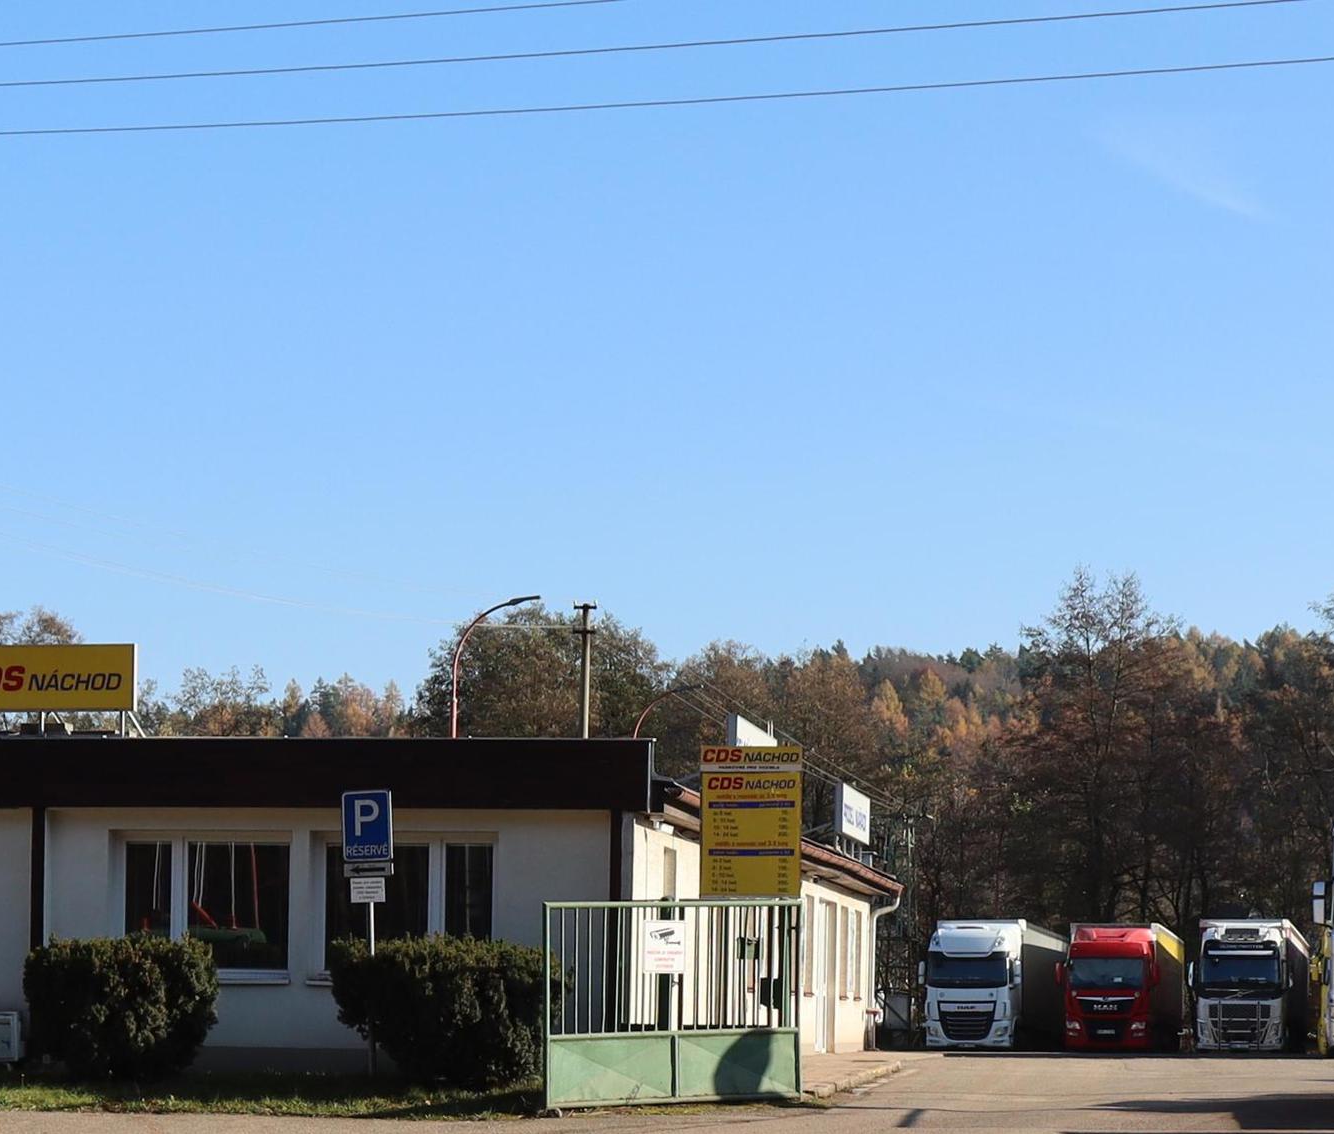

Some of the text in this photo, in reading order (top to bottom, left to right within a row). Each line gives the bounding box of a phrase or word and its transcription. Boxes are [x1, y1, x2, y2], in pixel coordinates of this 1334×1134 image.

[28, 669, 122, 692] NÁCHOD
[702, 748, 743, 763] CDS
[707, 776, 744, 790] CDS
[354, 799, 380, 837] P
[346, 844, 389, 857] RÉSERVÉ
